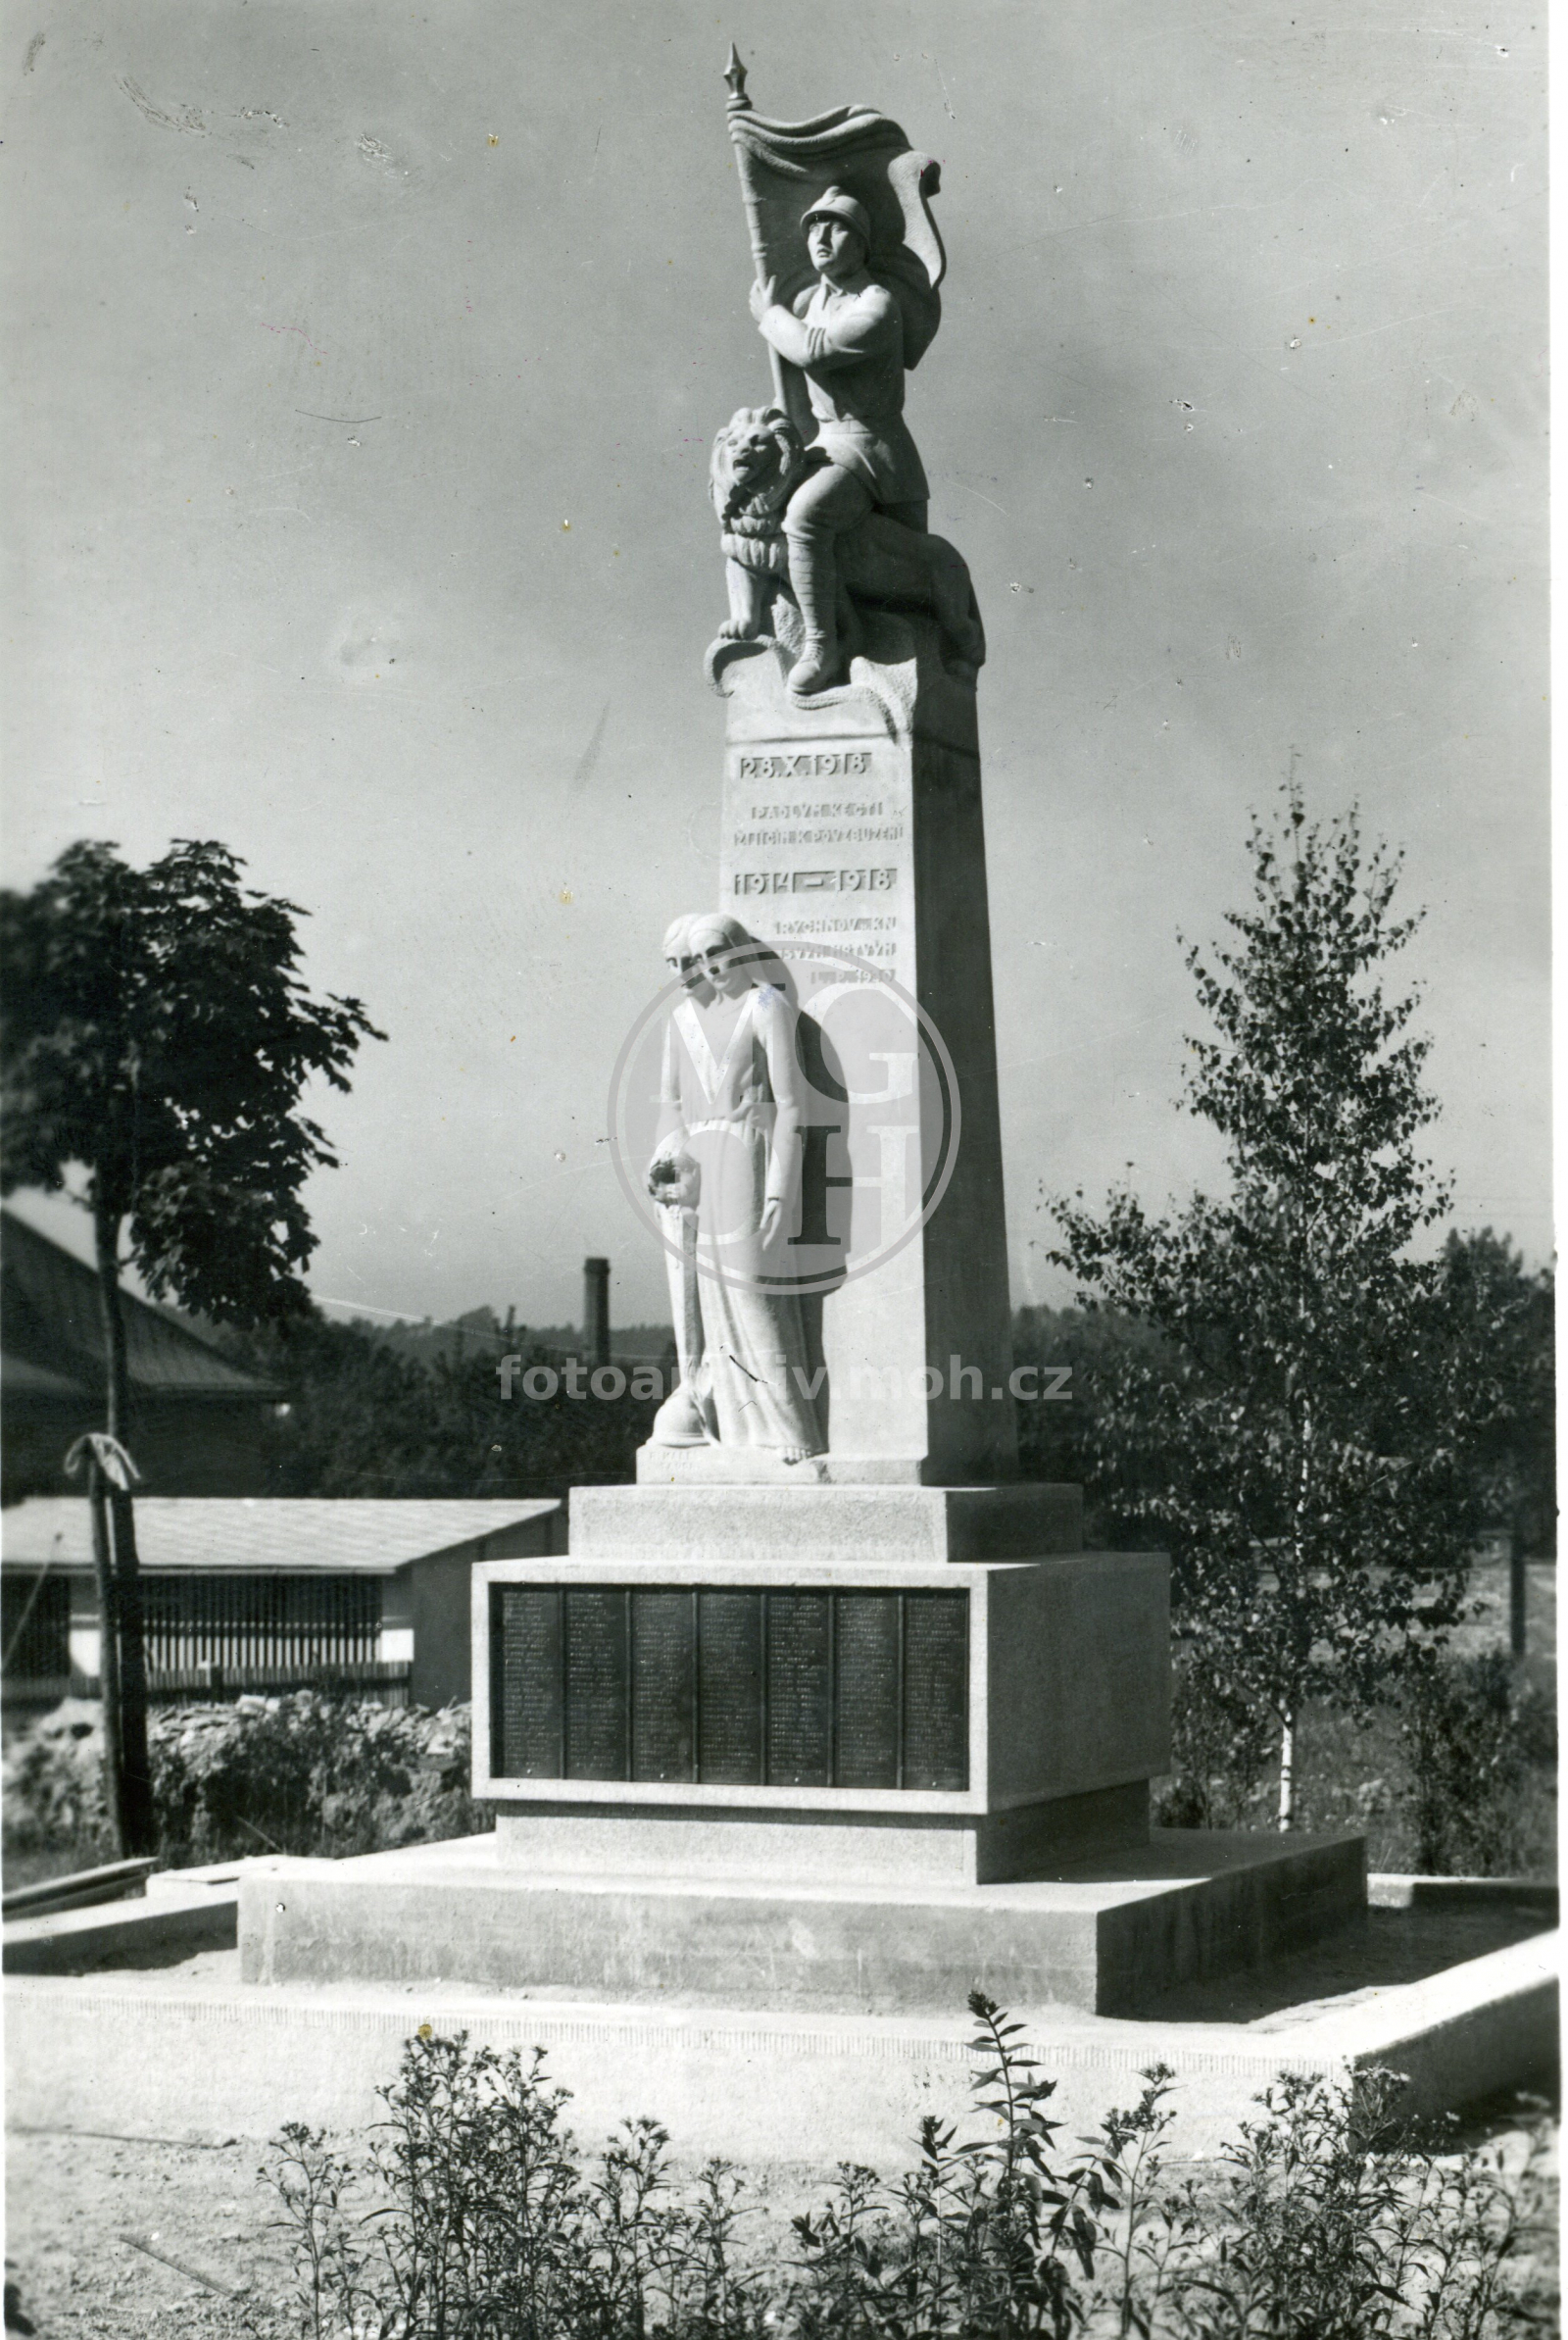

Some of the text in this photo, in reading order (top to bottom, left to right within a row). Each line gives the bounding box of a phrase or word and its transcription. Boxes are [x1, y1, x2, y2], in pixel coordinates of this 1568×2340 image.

[740, 753, 871, 778] 28.X.1918
[734, 872, 795, 896] 1914
[833, 868, 897, 892] 1918
